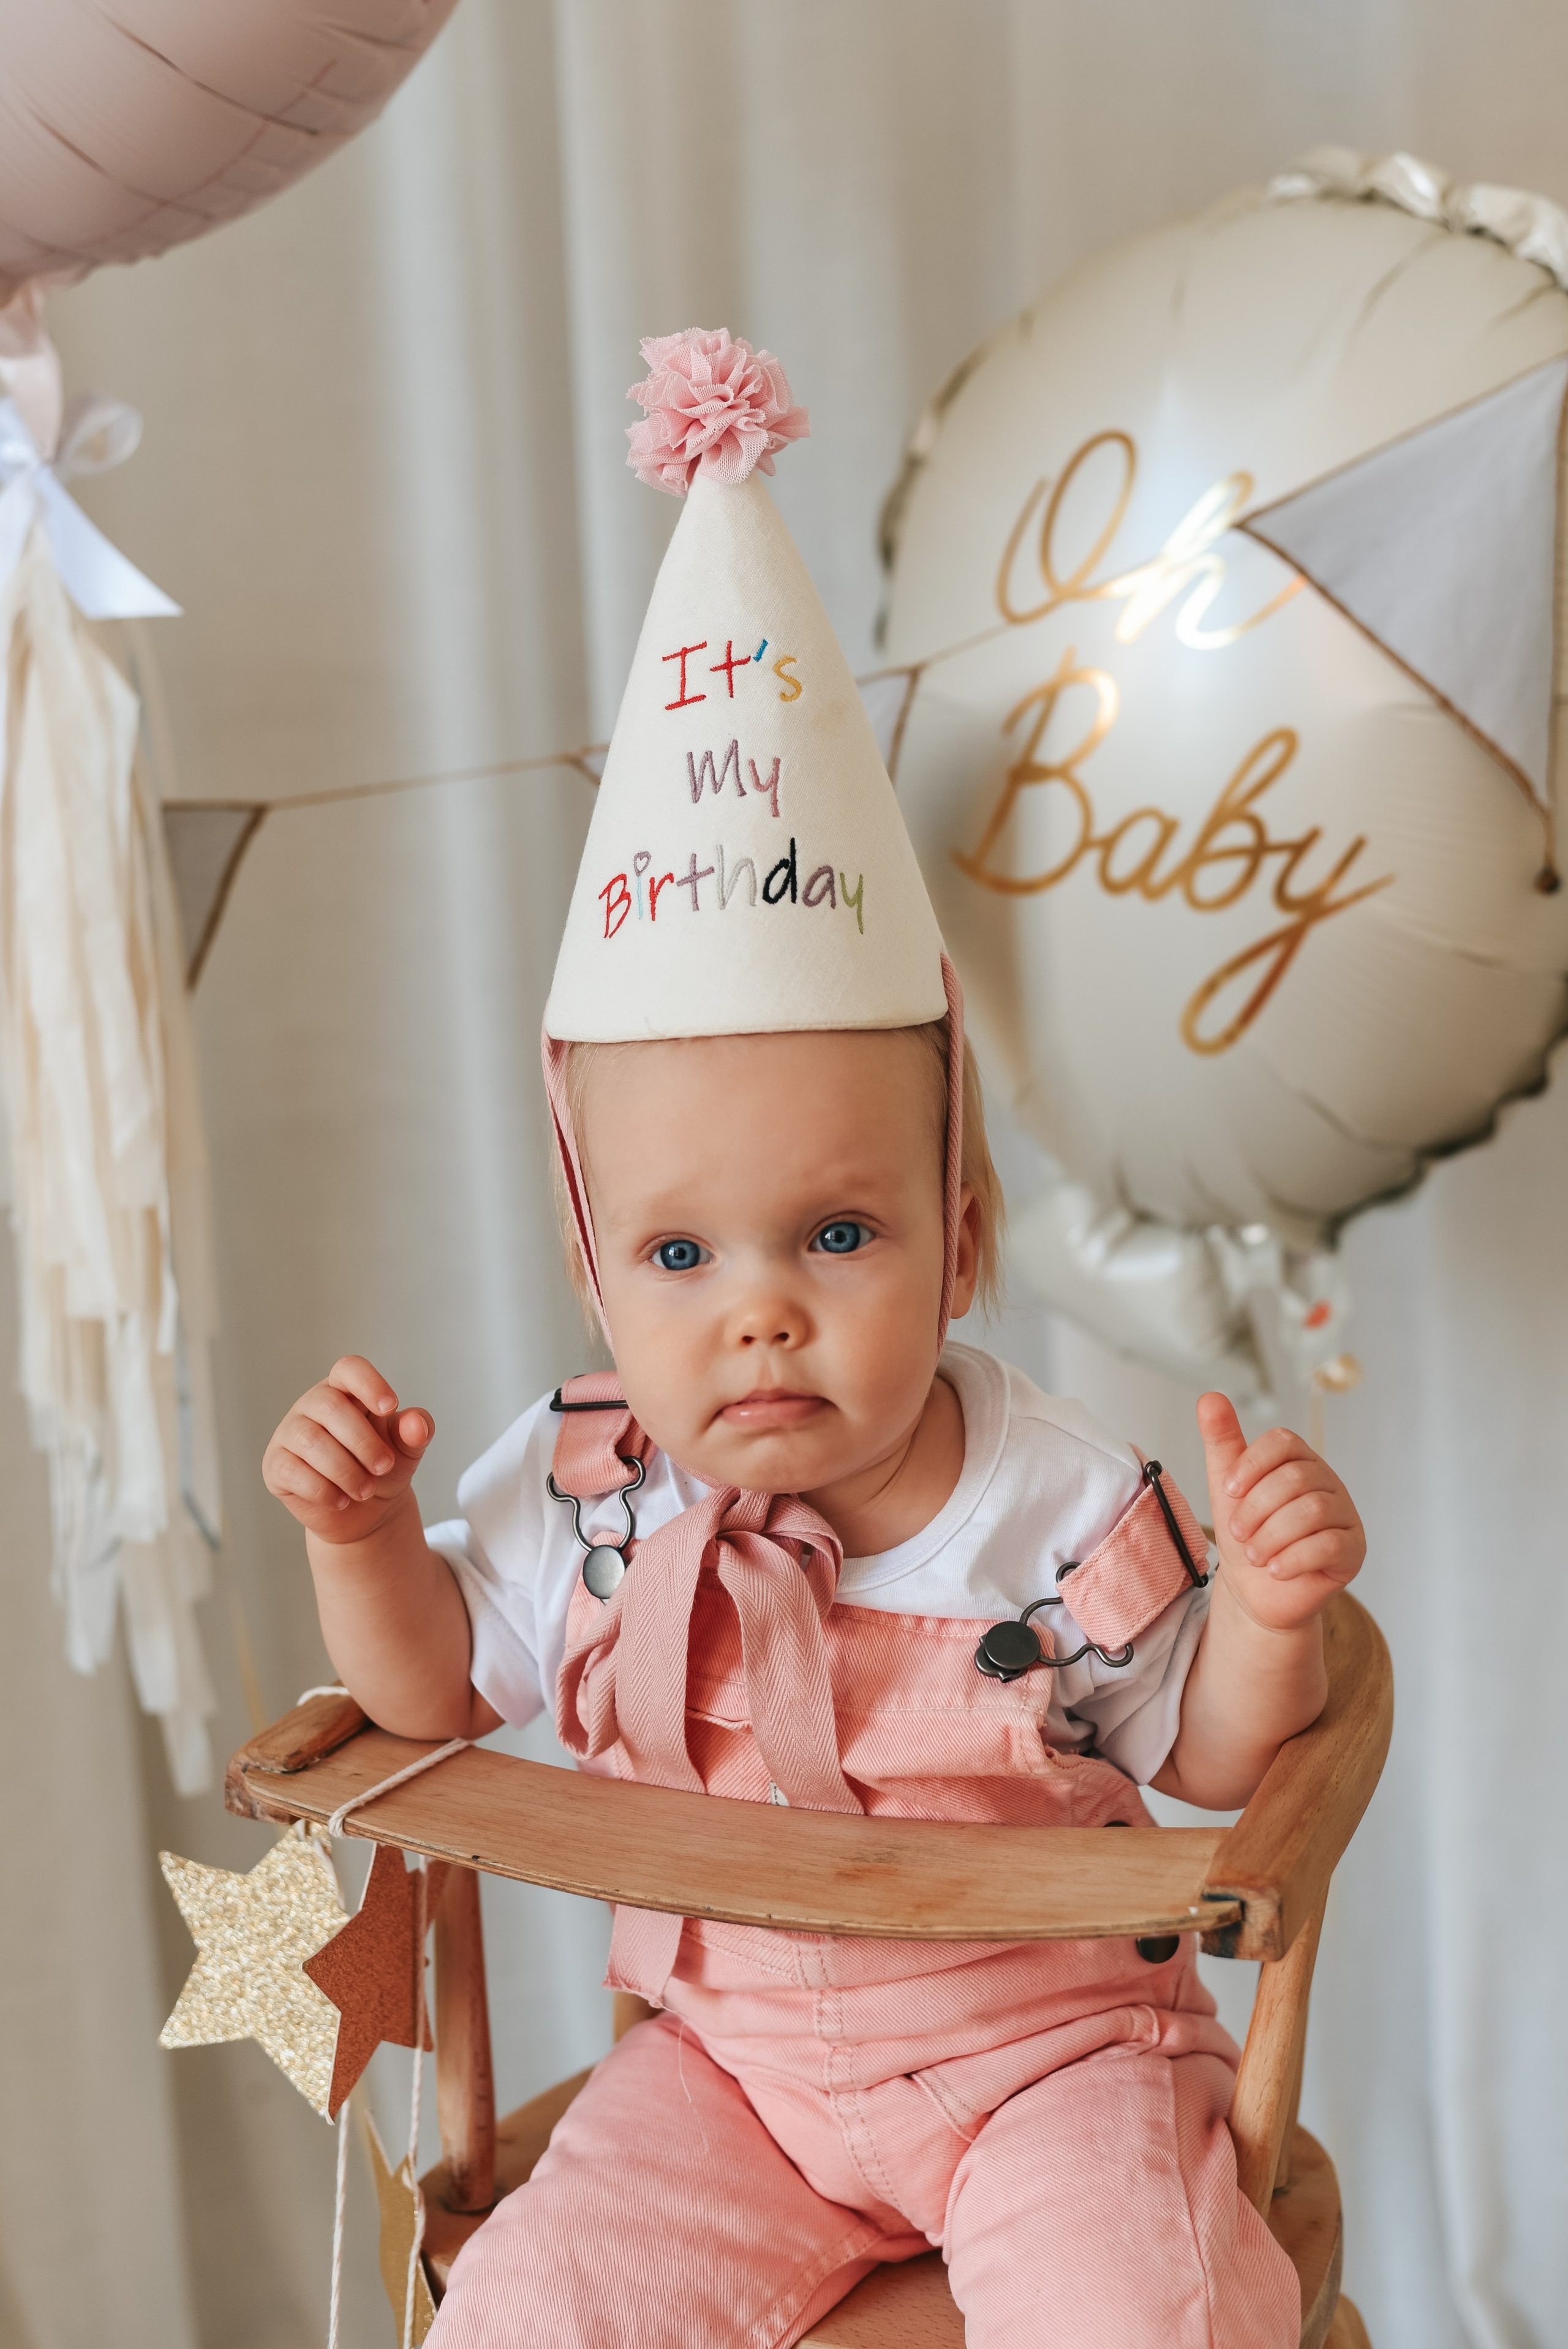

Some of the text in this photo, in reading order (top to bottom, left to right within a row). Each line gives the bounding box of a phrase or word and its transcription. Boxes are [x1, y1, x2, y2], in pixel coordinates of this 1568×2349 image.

[997, 430, 1307, 650] Oh
[662, 639, 803, 711] It's
[686, 738, 781, 818] My
[598, 837, 865, 939] Birthday
[948, 646, 1397, 1056] Baby
